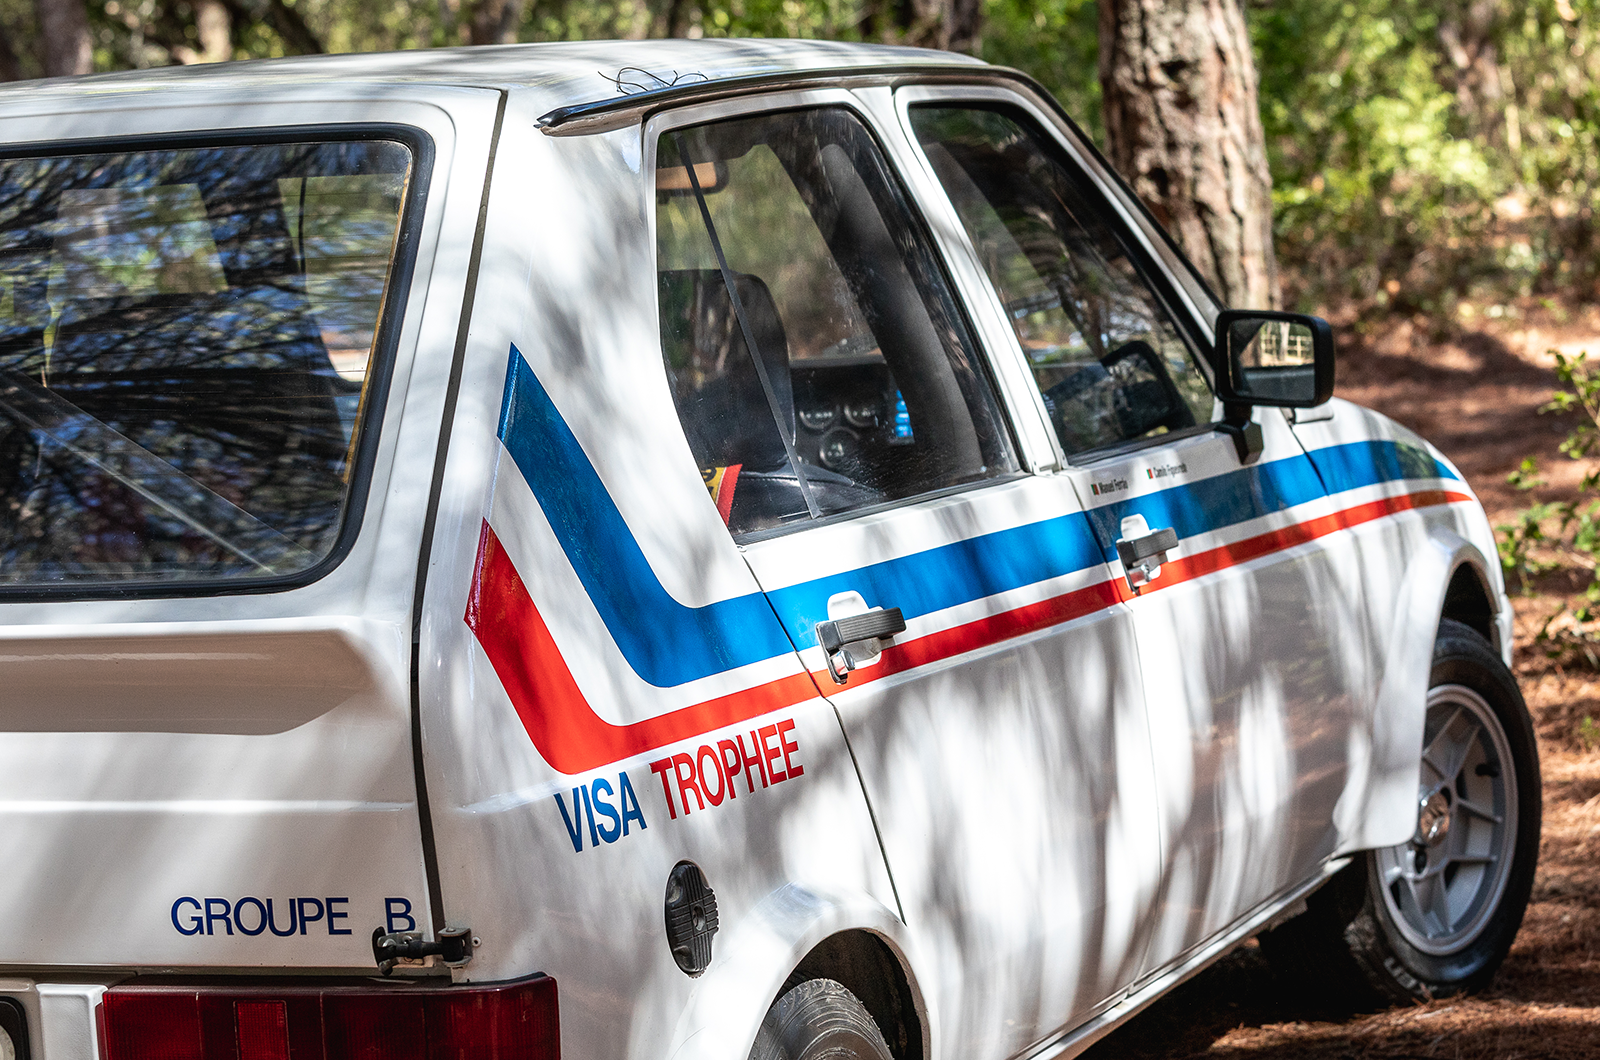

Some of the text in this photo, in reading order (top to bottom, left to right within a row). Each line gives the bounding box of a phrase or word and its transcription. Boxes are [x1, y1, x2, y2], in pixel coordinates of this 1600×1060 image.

[553, 718, 805, 853] VISA TROPHEE
[170, 896, 416, 937] GROUPE B
